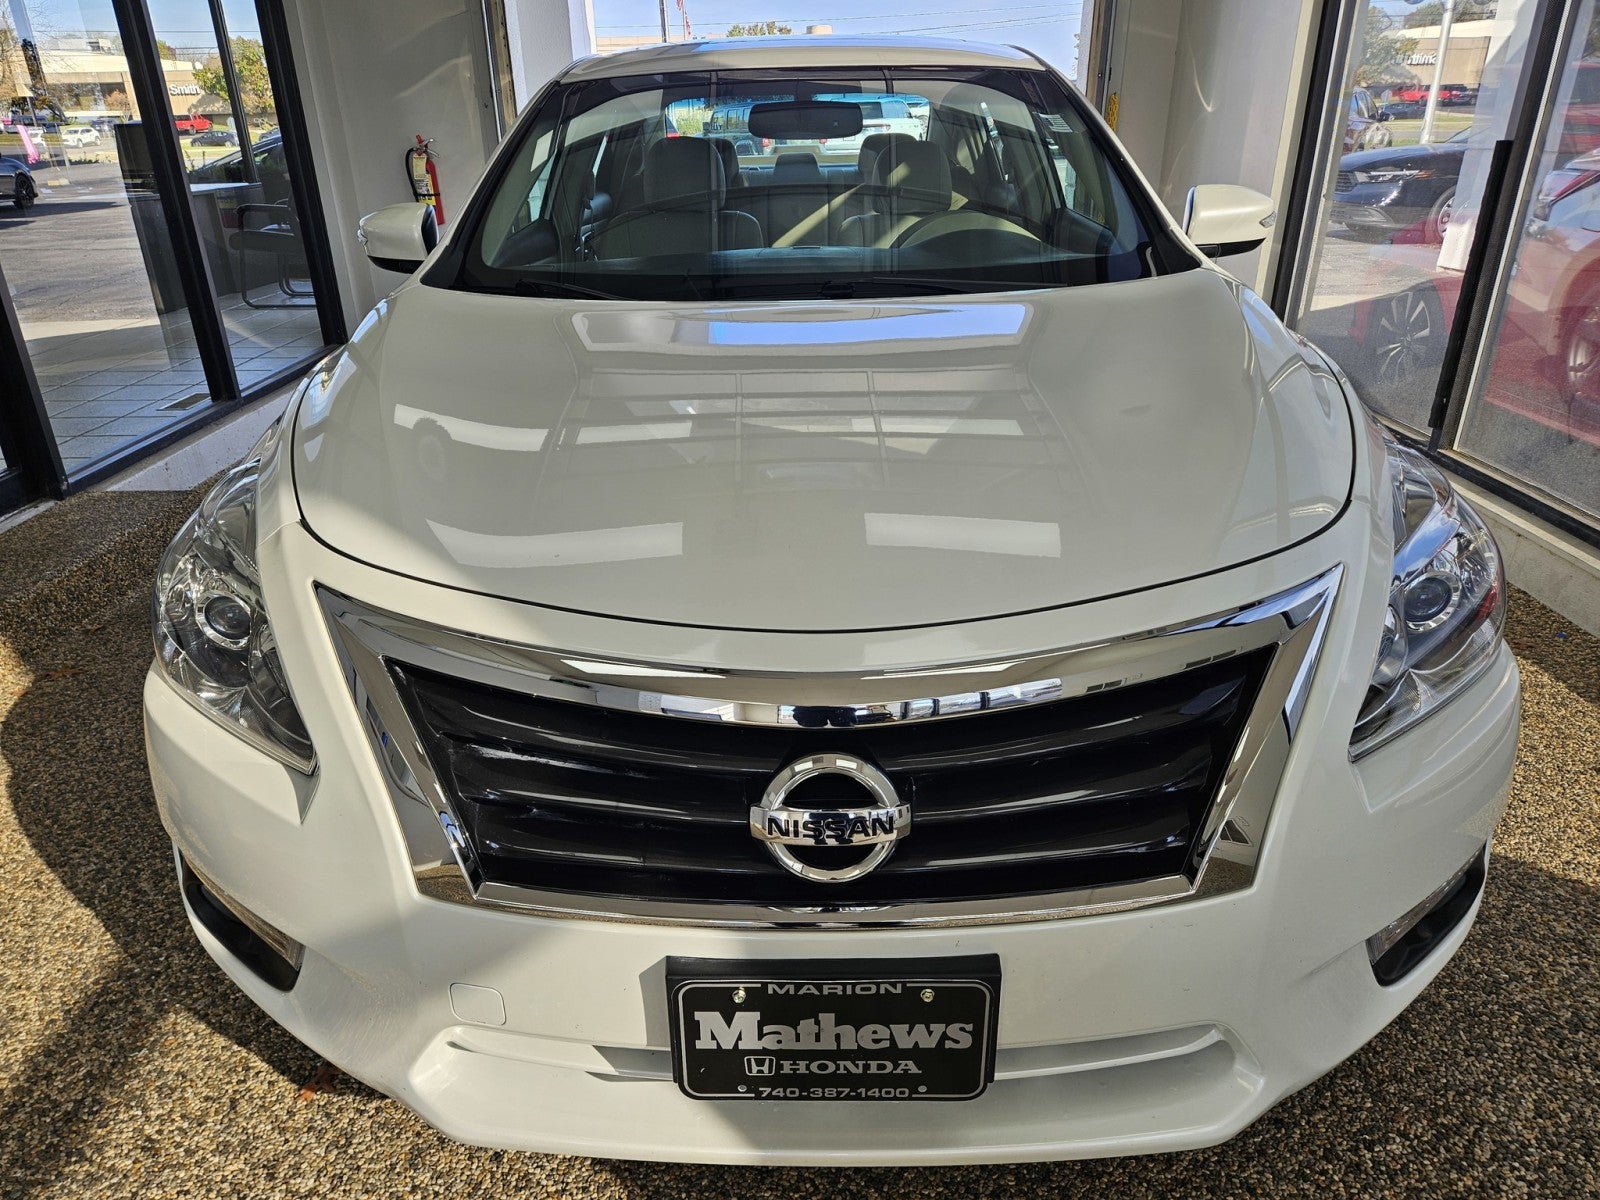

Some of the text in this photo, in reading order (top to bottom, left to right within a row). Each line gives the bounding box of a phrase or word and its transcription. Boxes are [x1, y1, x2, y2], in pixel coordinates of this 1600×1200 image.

[169, 84, 201, 95] Smith
[767, 816, 894, 840] NISSAN
[767, 983, 902, 995] MARION
[693, 1011, 974, 1050] Mathews
[779, 1060, 922, 1074] HONDA
[758, 1086, 911, 1099] 740-387-1400
